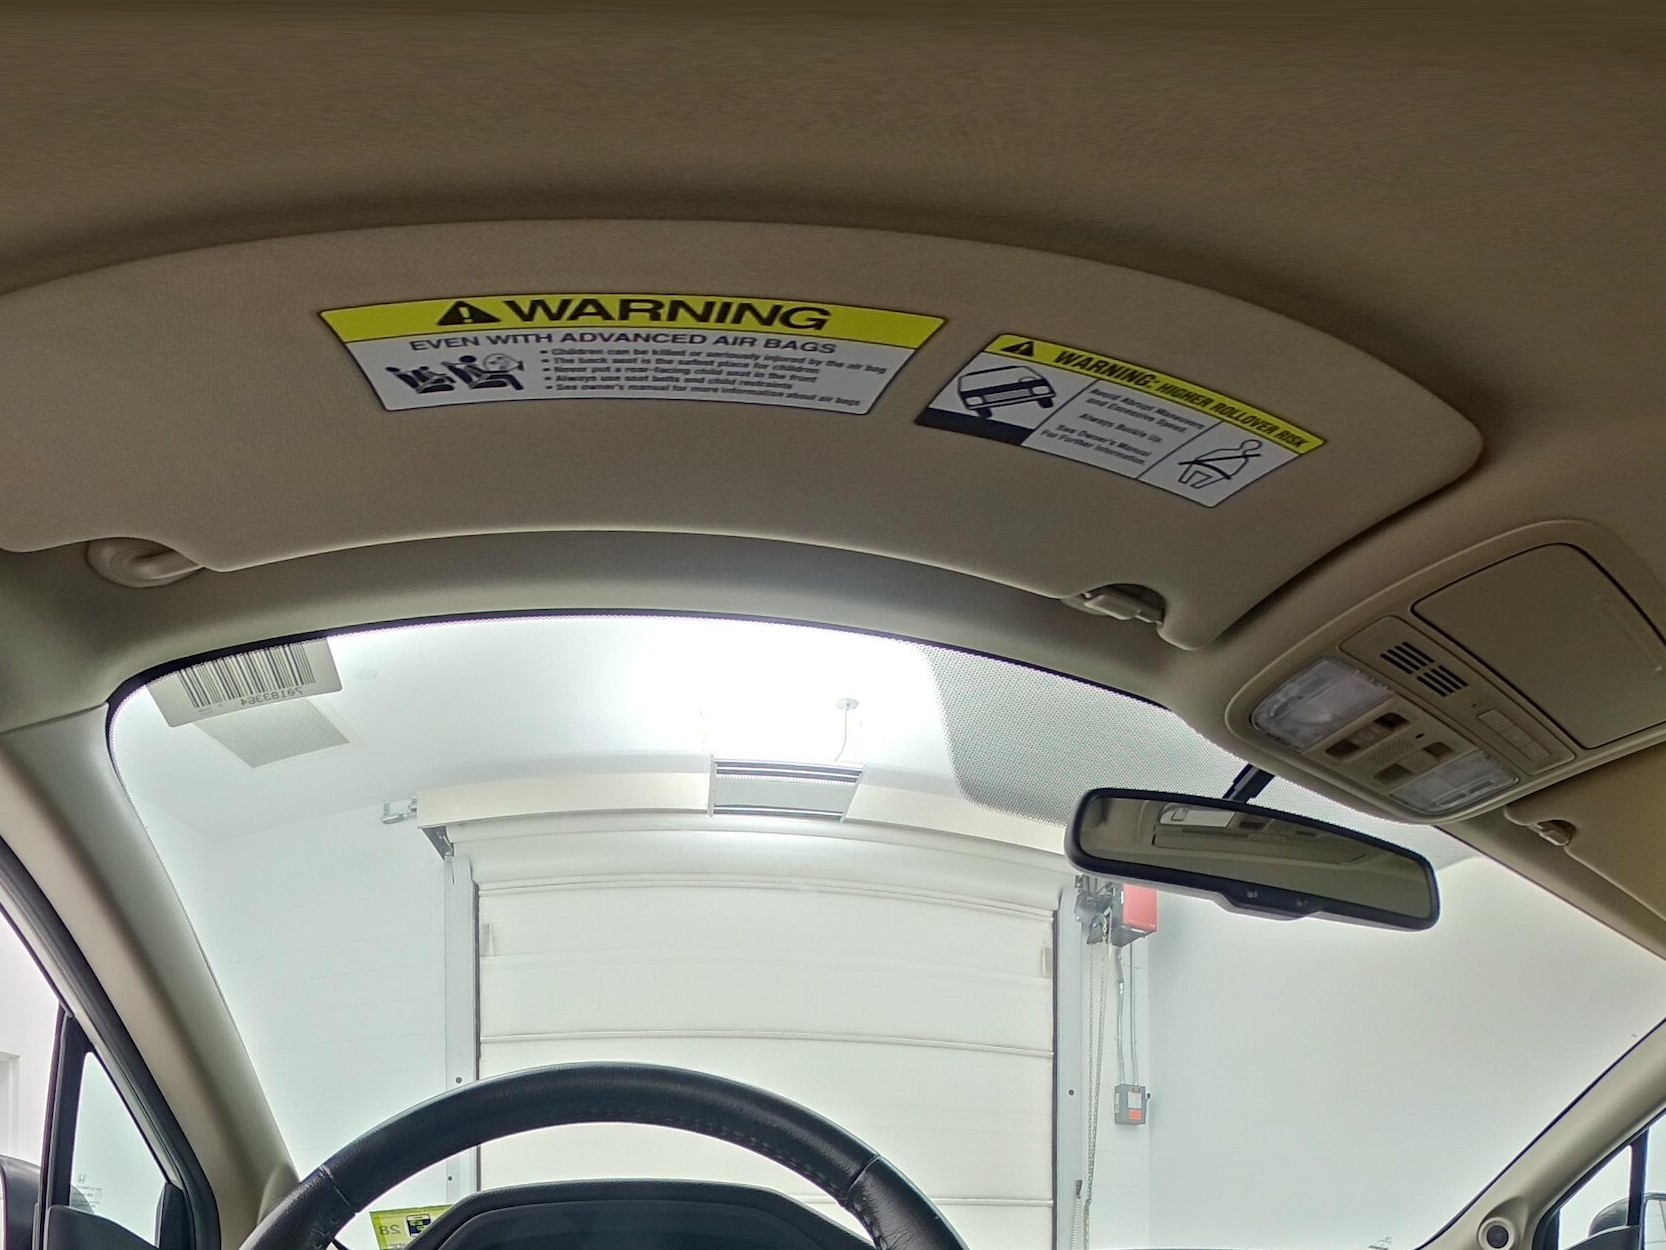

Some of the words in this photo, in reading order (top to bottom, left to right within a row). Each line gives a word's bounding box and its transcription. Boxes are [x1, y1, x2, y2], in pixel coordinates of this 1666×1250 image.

[503, 298, 831, 331] WARNING
[410, 337, 480, 351] EVEN
[485, 332, 553, 345] WITH
[560, 332, 708, 346] ADVANCED
[712, 335, 757, 348] AIR
[763, 339, 837, 354] BAGS
[551, 348, 604, 356] Children
[633, 348, 648, 356] be
[652, 349, 686, 357] killed
[764, 353, 807, 364] injured
[809, 357, 823, 367] by
[826, 359, 845, 368] the
[847, 362, 863, 371] air
[866, 364, 887, 375] bag
[554, 357, 575, 365] The
[579, 356, 608, 365] back
[612, 356, 637, 365] seat
[655, 357, 675, 366] the
[678, 358, 715, 367] safest
[717, 360, 750, 369] place
[753, 362, 770, 371] for
[772, 363, 820, 375] children
[624, 375, 649, 383] seat
[684, 376, 705, 384] and
[708, 377, 737, 386] child
[694, 367, 723, 376] child
[726, 369, 751, 378] seat
[754, 371, 766, 379] in
[768, 372, 787, 381] the
[789, 374, 818, 384] front
[786, 391, 818, 402] about
[818, 394, 834, 403] air
[836, 397, 861, 407] bags
[1053, 350, 1154, 389] WARNING:
[1155, 381, 1211, 411] HIGHER
[1212, 399, 1280, 437] ROLLOVER
[1274, 426, 1309, 450] RISK
